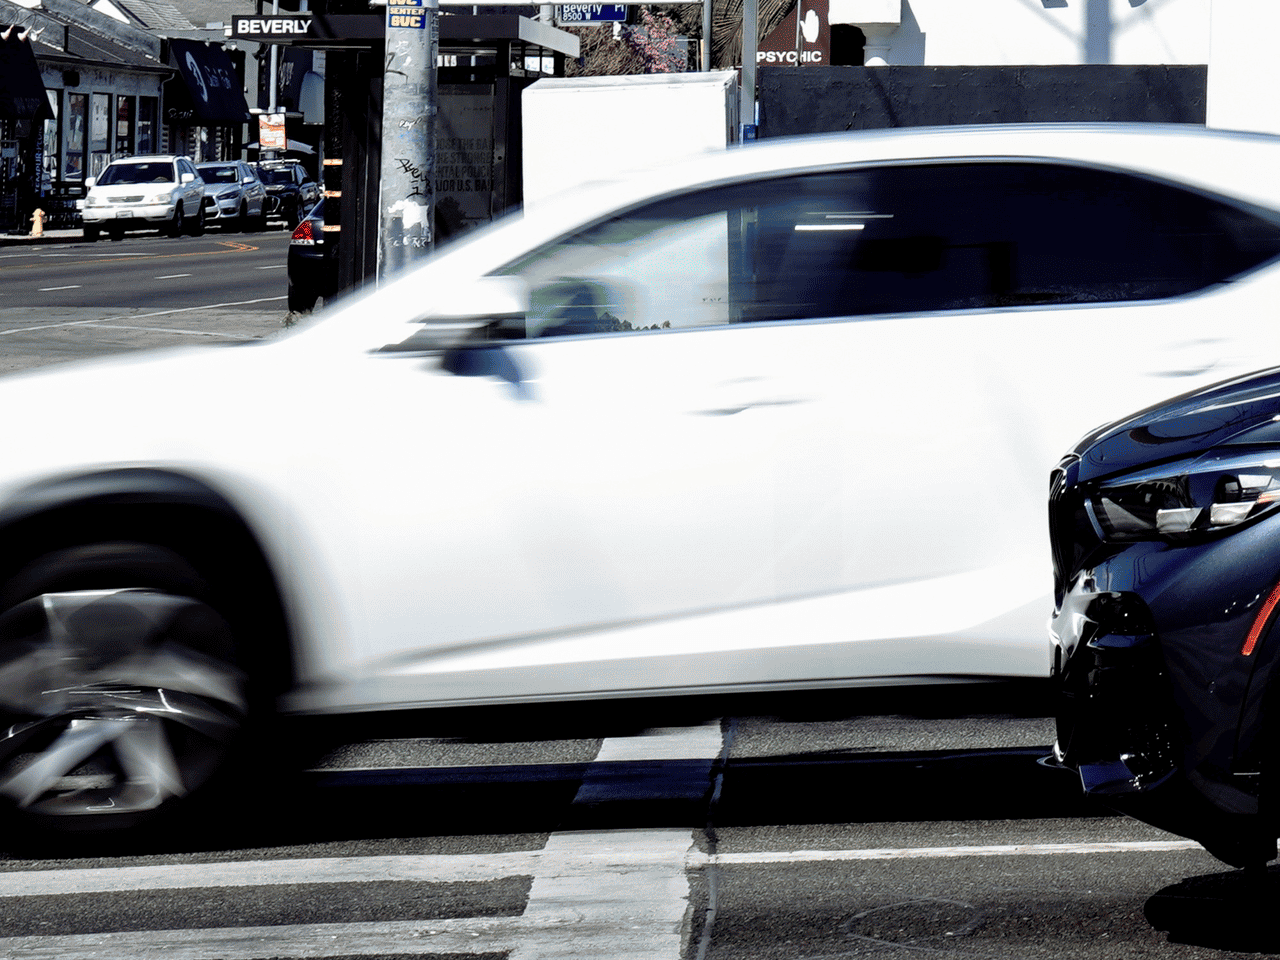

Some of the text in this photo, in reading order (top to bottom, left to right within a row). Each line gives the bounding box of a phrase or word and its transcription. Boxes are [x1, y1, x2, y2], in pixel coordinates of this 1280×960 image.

[563, 4, 602, 16] Beverly
[562, 12, 582, 21] 8500
[237, 19, 312, 34] BEVERLY
